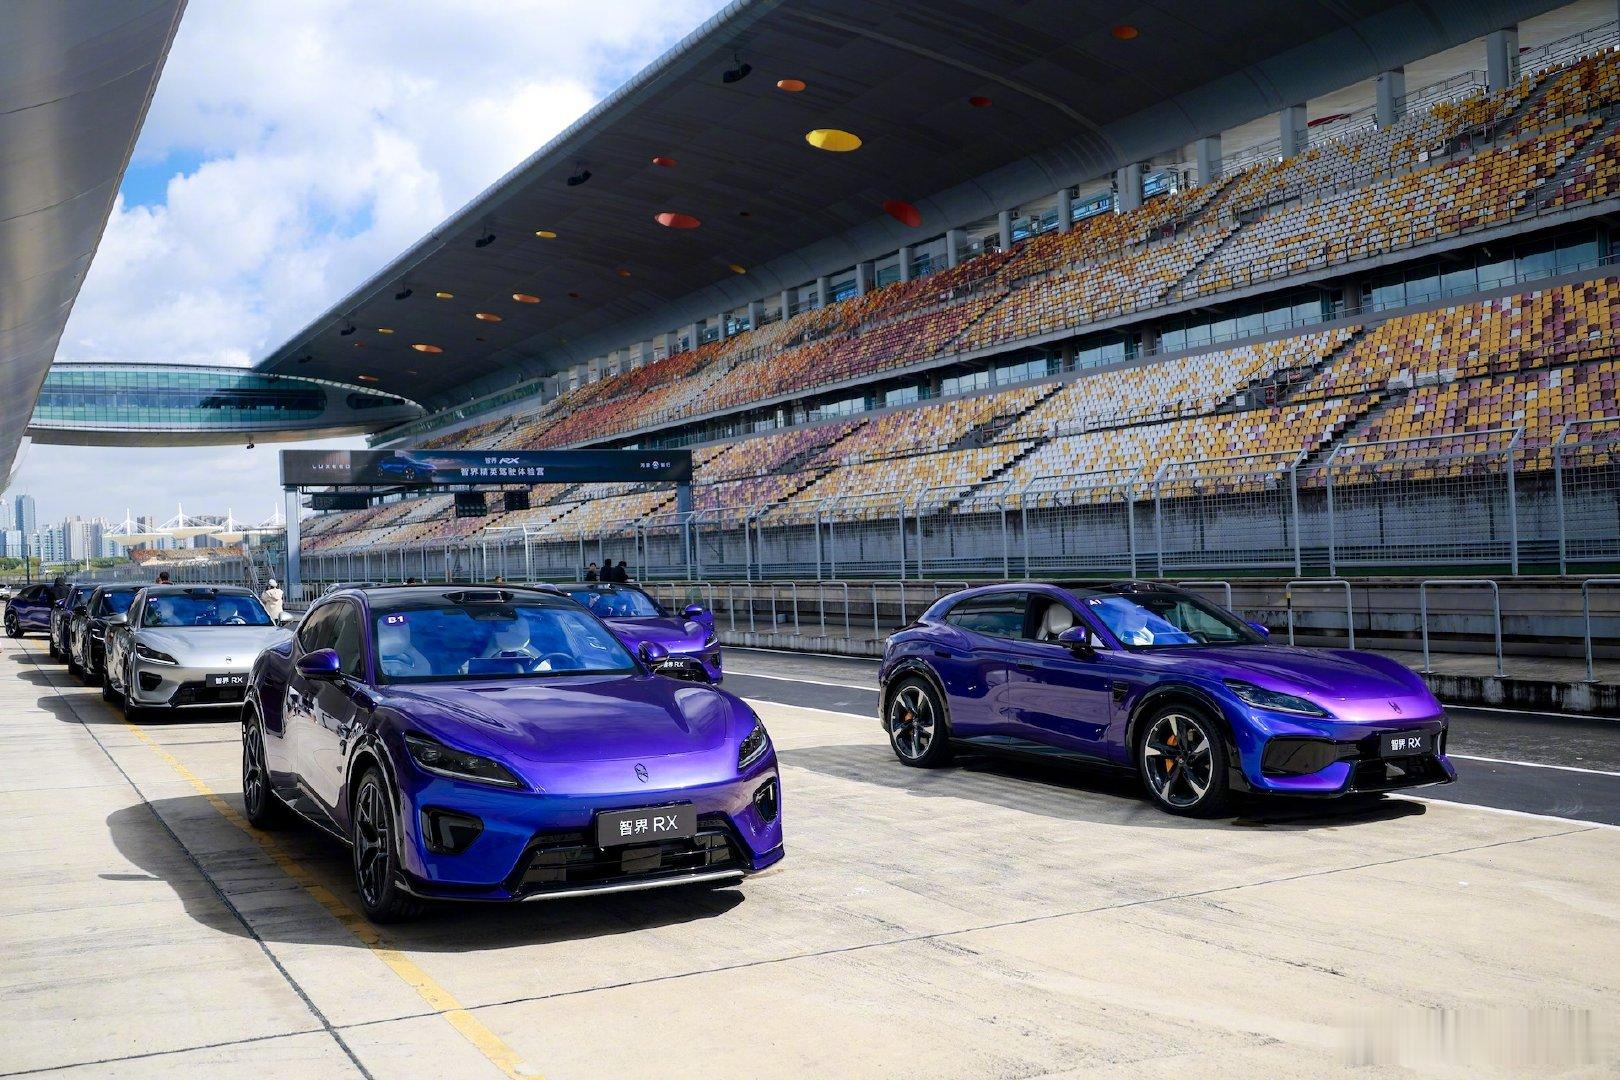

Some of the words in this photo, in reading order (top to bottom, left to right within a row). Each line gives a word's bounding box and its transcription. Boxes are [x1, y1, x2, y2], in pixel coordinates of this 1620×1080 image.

[388, 615, 404, 624] B1
[231, 676, 243, 684] RX
[1390, 738, 1406, 751] 智界
[1408, 736, 1421, 749] RX
[619, 818, 649, 837] 智界
[653, 814, 678, 832] RX
